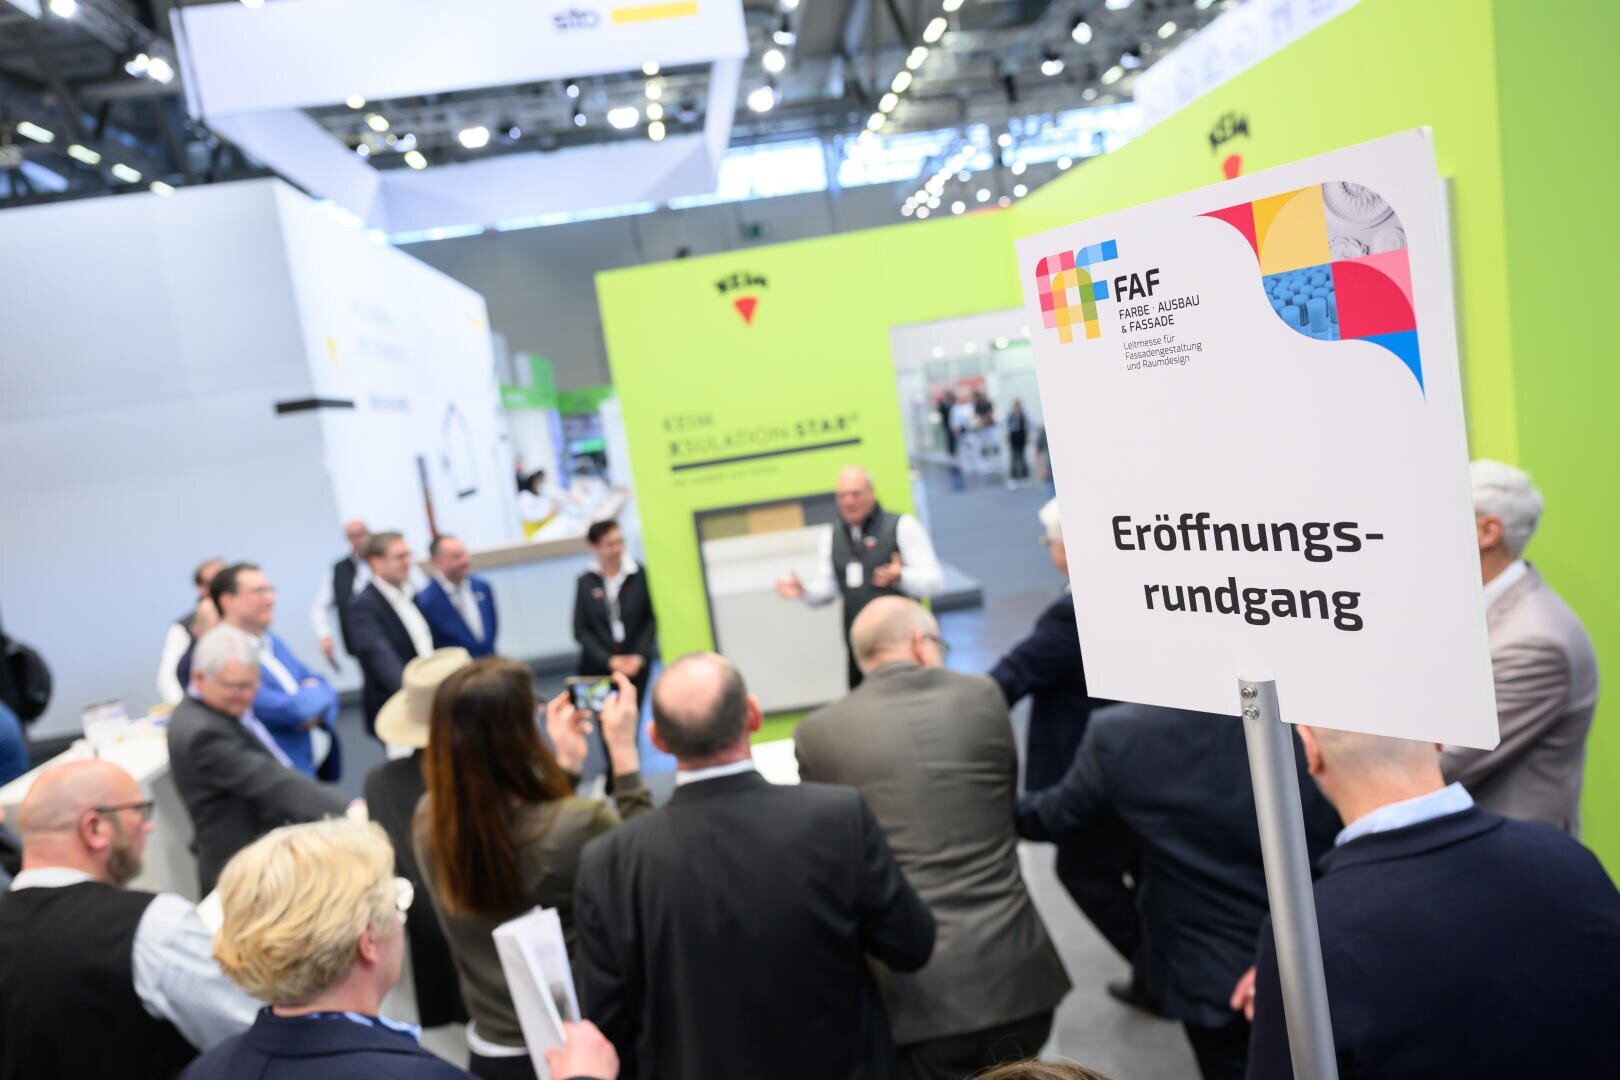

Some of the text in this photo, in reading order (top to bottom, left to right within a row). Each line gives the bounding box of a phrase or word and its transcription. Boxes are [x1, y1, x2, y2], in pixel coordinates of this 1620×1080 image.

[715, 271, 768, 293] KEIM
[1114, 268, 1160, 302] FAF
[1119, 295, 1200, 320] FARBE AUSBAU
[1121, 314, 1175, 333] & FASSADE
[1123, 334, 1175, 351] Leitmesse für
[1125, 342, 1203, 360] Fassadengestaltung
[1127, 354, 1190, 370] und Raumdesign
[1112, 512, 1384, 562] Eröffnungs-
[1144, 577, 1363, 631] rundgang
